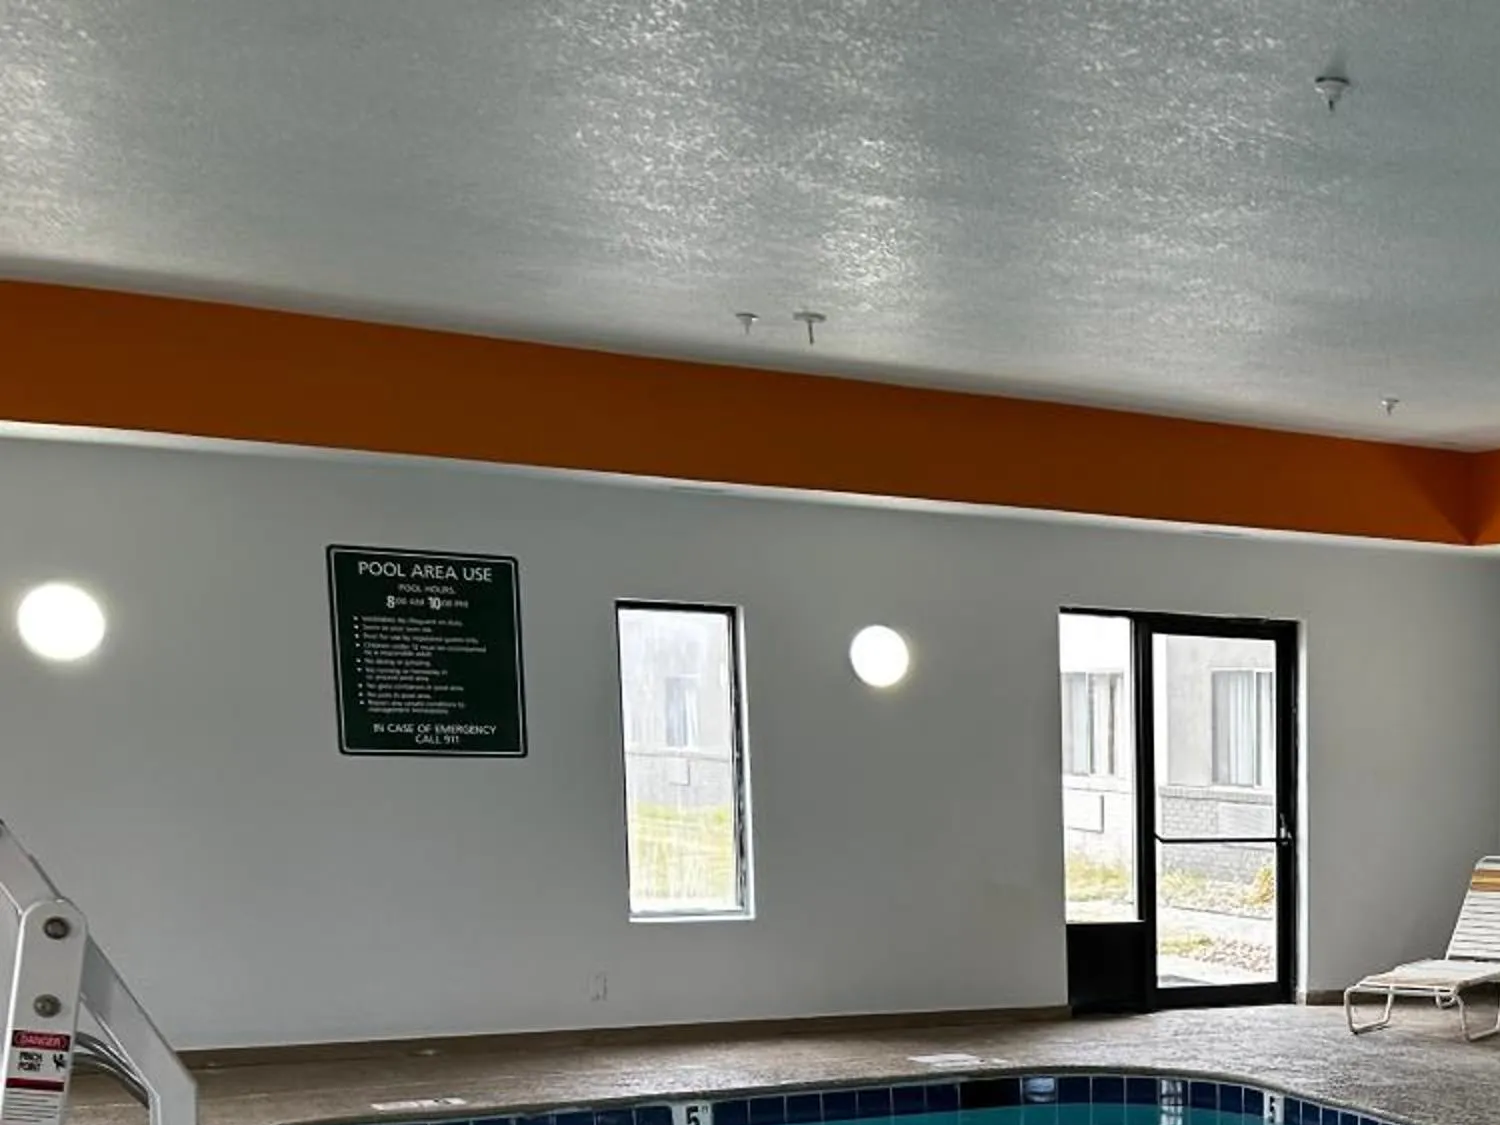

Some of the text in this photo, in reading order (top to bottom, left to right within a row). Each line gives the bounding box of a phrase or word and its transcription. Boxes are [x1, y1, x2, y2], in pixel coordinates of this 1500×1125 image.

[358, 561, 493, 582] POOL AREA USE
[373, 723, 497, 736] IN CASE OF EMERGENCY
[415, 735, 441, 745] CALL
